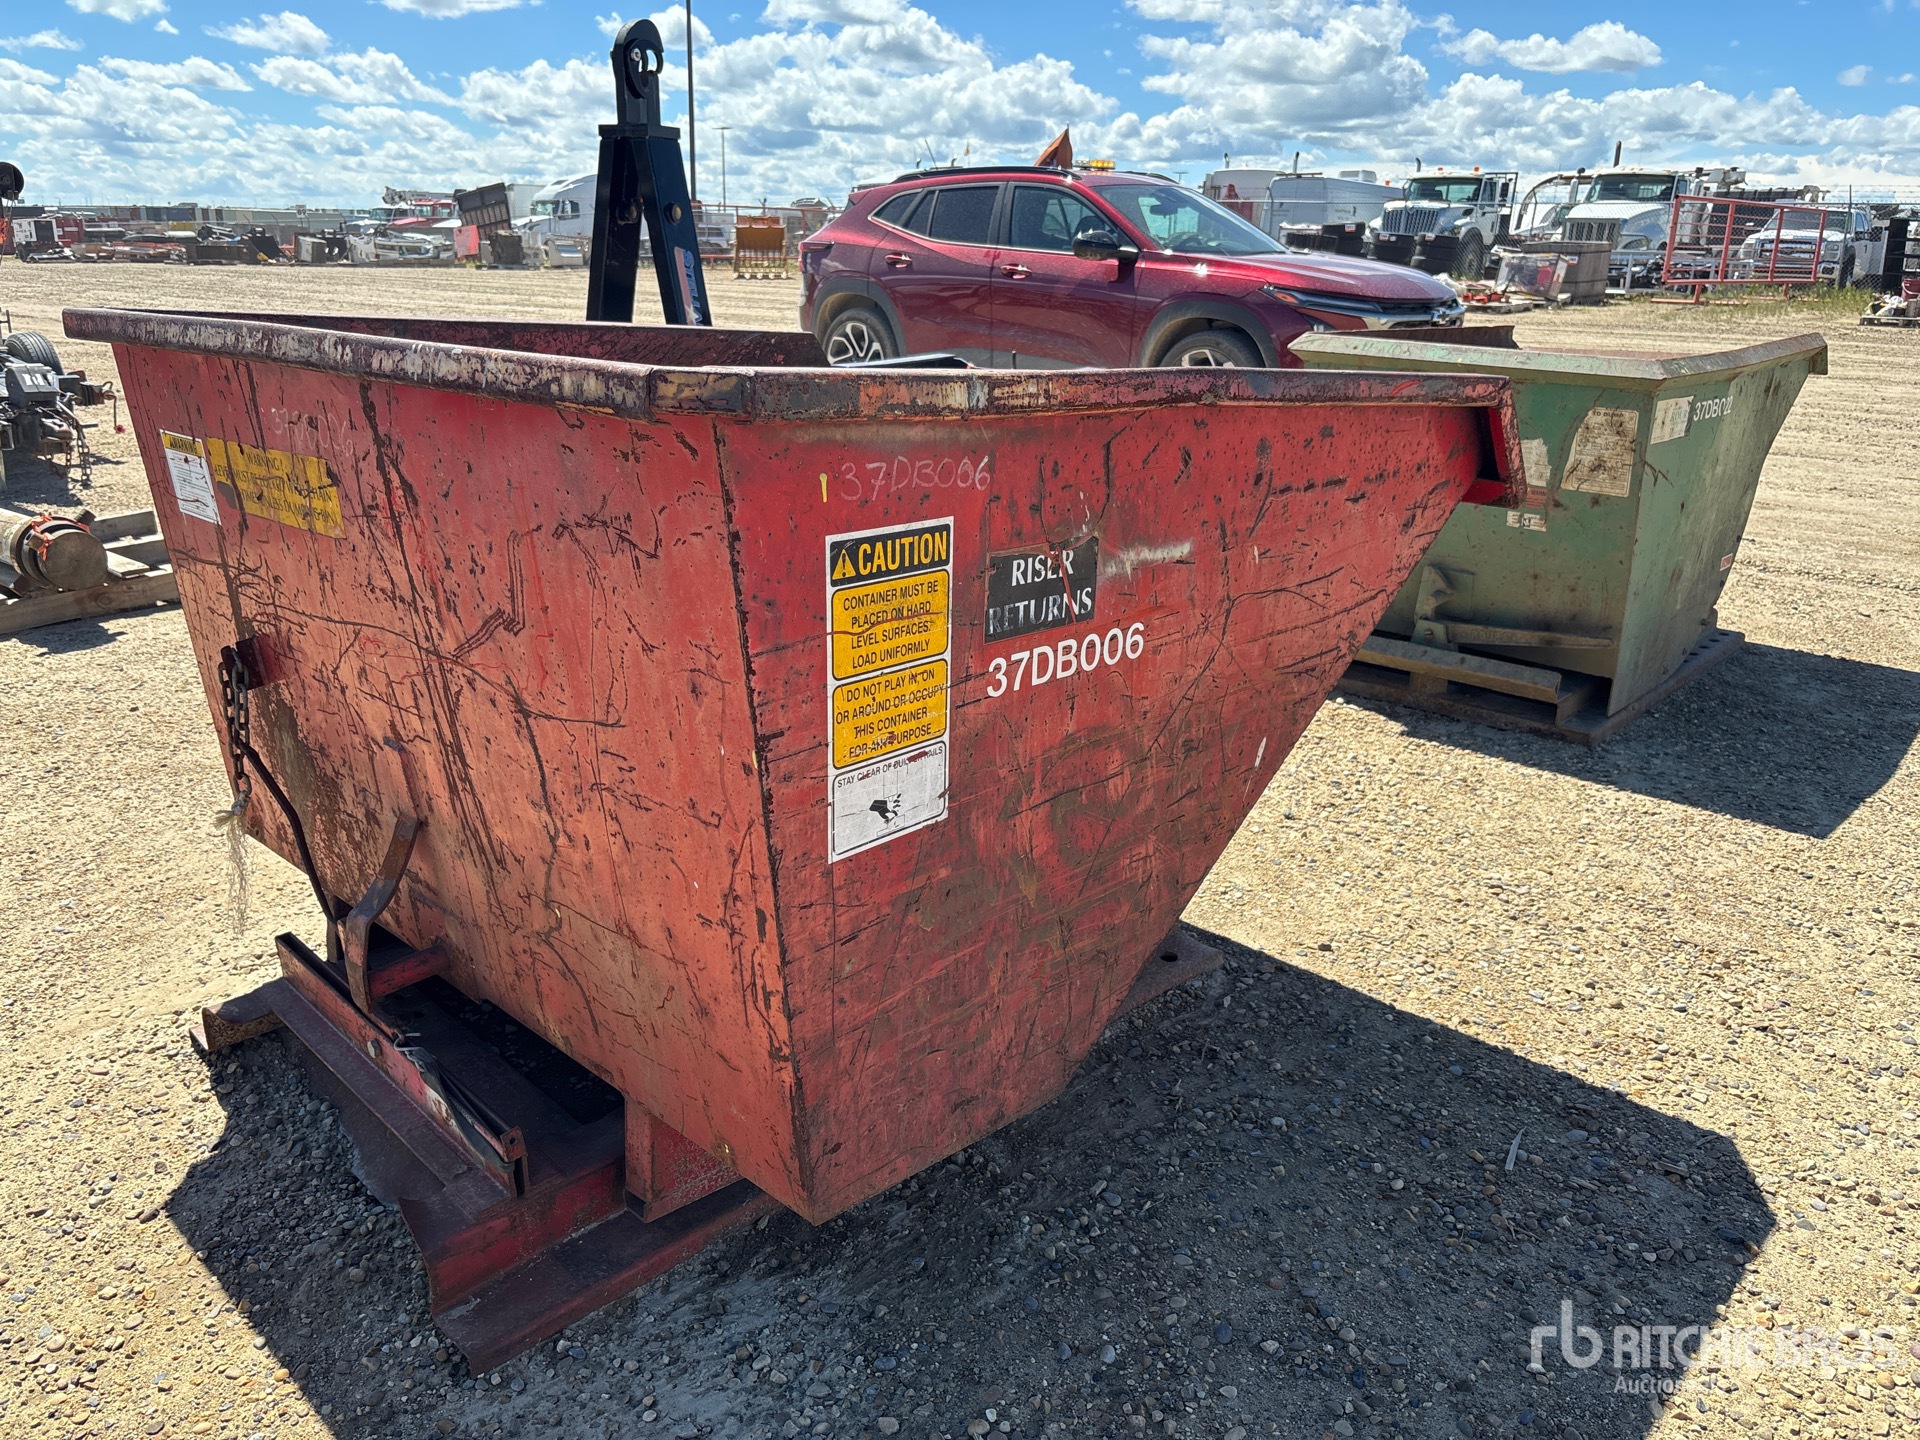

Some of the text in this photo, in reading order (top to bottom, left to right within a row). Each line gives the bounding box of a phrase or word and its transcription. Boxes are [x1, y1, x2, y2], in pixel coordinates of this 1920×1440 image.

[840, 455, 991, 502] 37DB006
[858, 530, 948, 576] CAUTION
[1011, 549, 1074, 587] RISER
[843, 580, 939, 611] CONTAINER MUST BE
[988, 587, 1092, 635] RETURNS
[851, 600, 931, 629] PLACED ON HARD
[851, 631, 879, 650] LEVEL
[852, 639, 931, 669] LOAD UNIFORMLY
[986, 622, 1144, 698] 37DB006
[846, 688, 861, 703] DO
[863, 682, 882, 697] NOT
[884, 675, 906, 693] PLAY
[922, 668, 935, 681] ON
[836, 683, 945, 725] OR AROUND OR OCCUPY
[853, 706, 928, 739] THIS CONTAINER
[848, 742, 869, 759] FOR
[837, 775, 856, 788] STAY
[857, 766, 881, 781] CLEAR
[882, 762, 892, 773] OF
